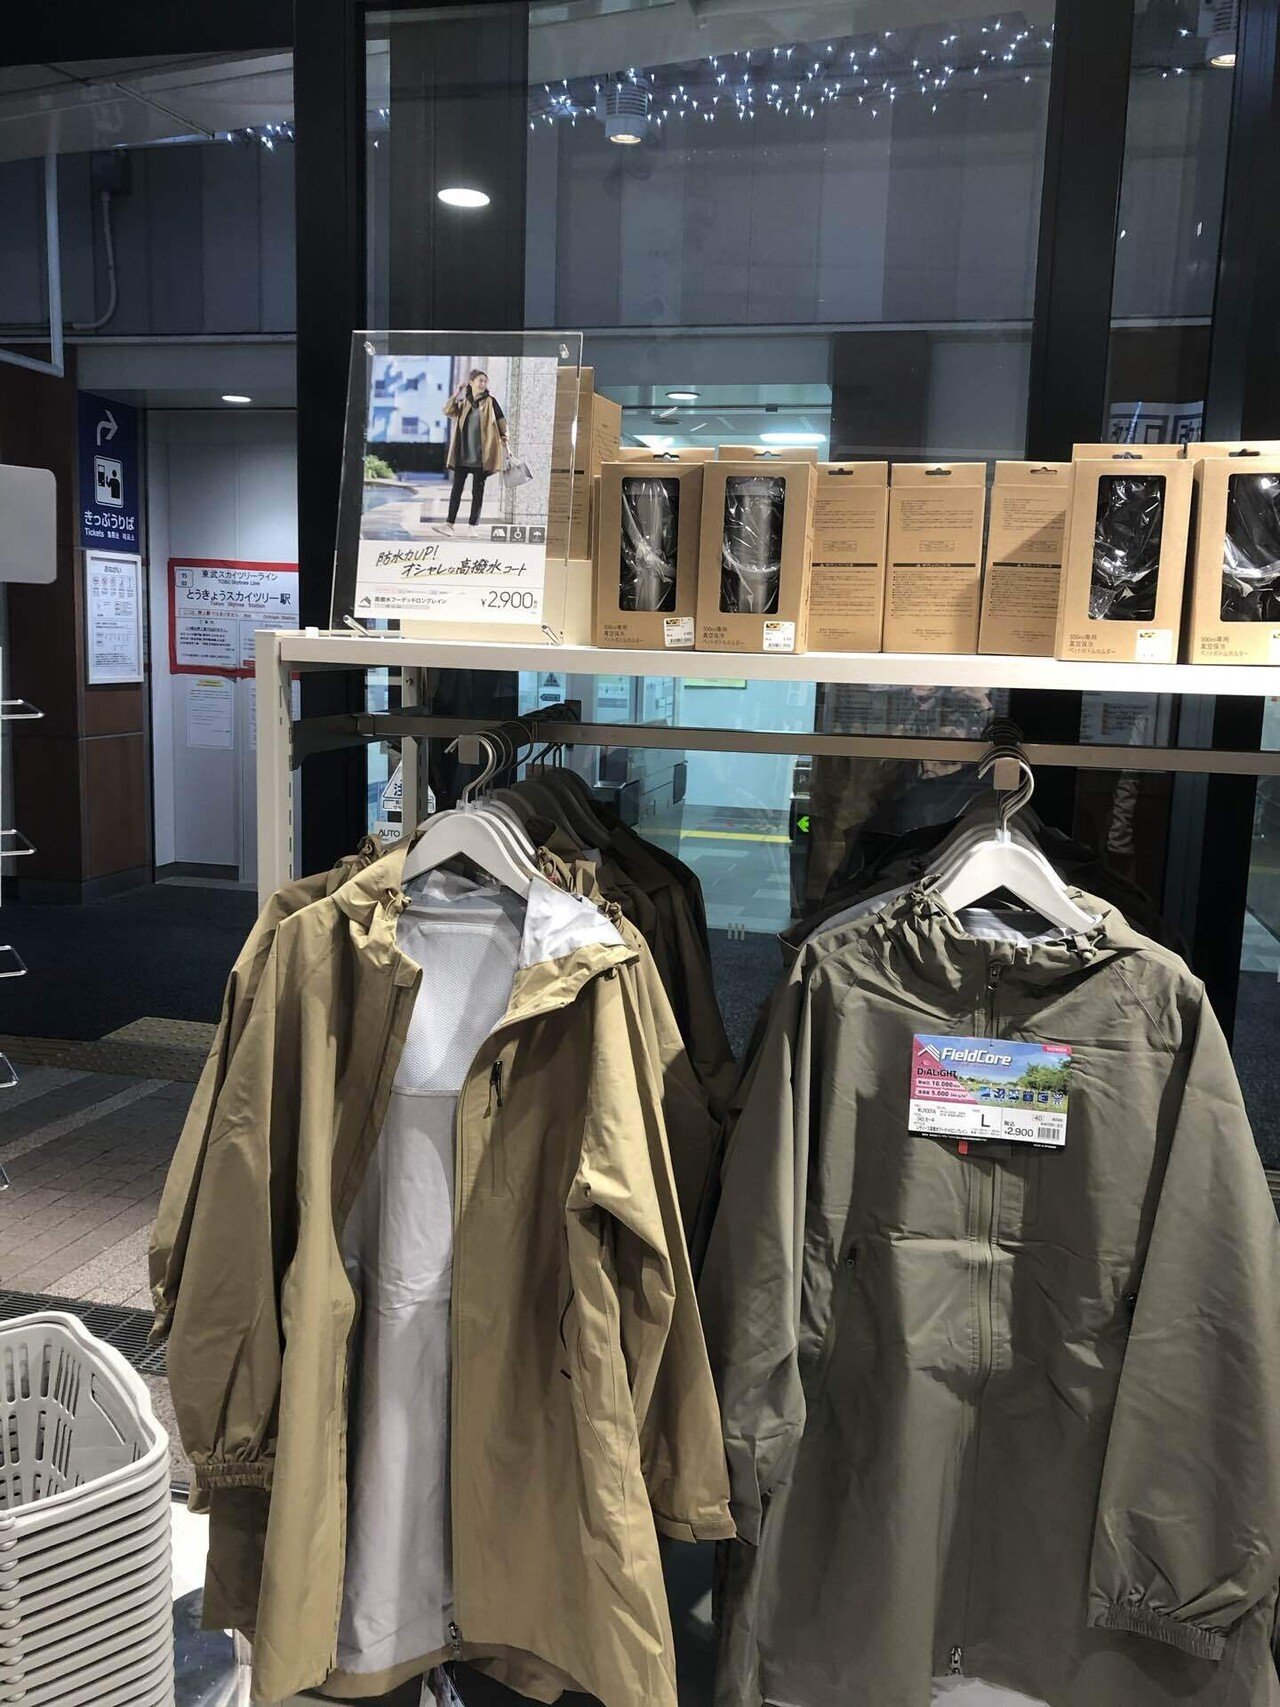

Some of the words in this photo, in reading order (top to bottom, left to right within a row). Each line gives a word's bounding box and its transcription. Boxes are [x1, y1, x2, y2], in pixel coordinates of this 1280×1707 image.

[84, 510, 135, 530] きっぷうりば
[84, 527, 105, 538] Tickets
[376, 545, 439, 567] 防水力UP!
[202, 570, 278, 581] 東武スカイツリーライン
[186, 589, 291, 605] とうきょうスカイツリー駅
[480, 591, 534, 609] ¥2,900
[379, 829, 400, 837] AUTO
[941, 1047, 1012, 1066] FieldCore
[981, 1113, 991, 1128] L
